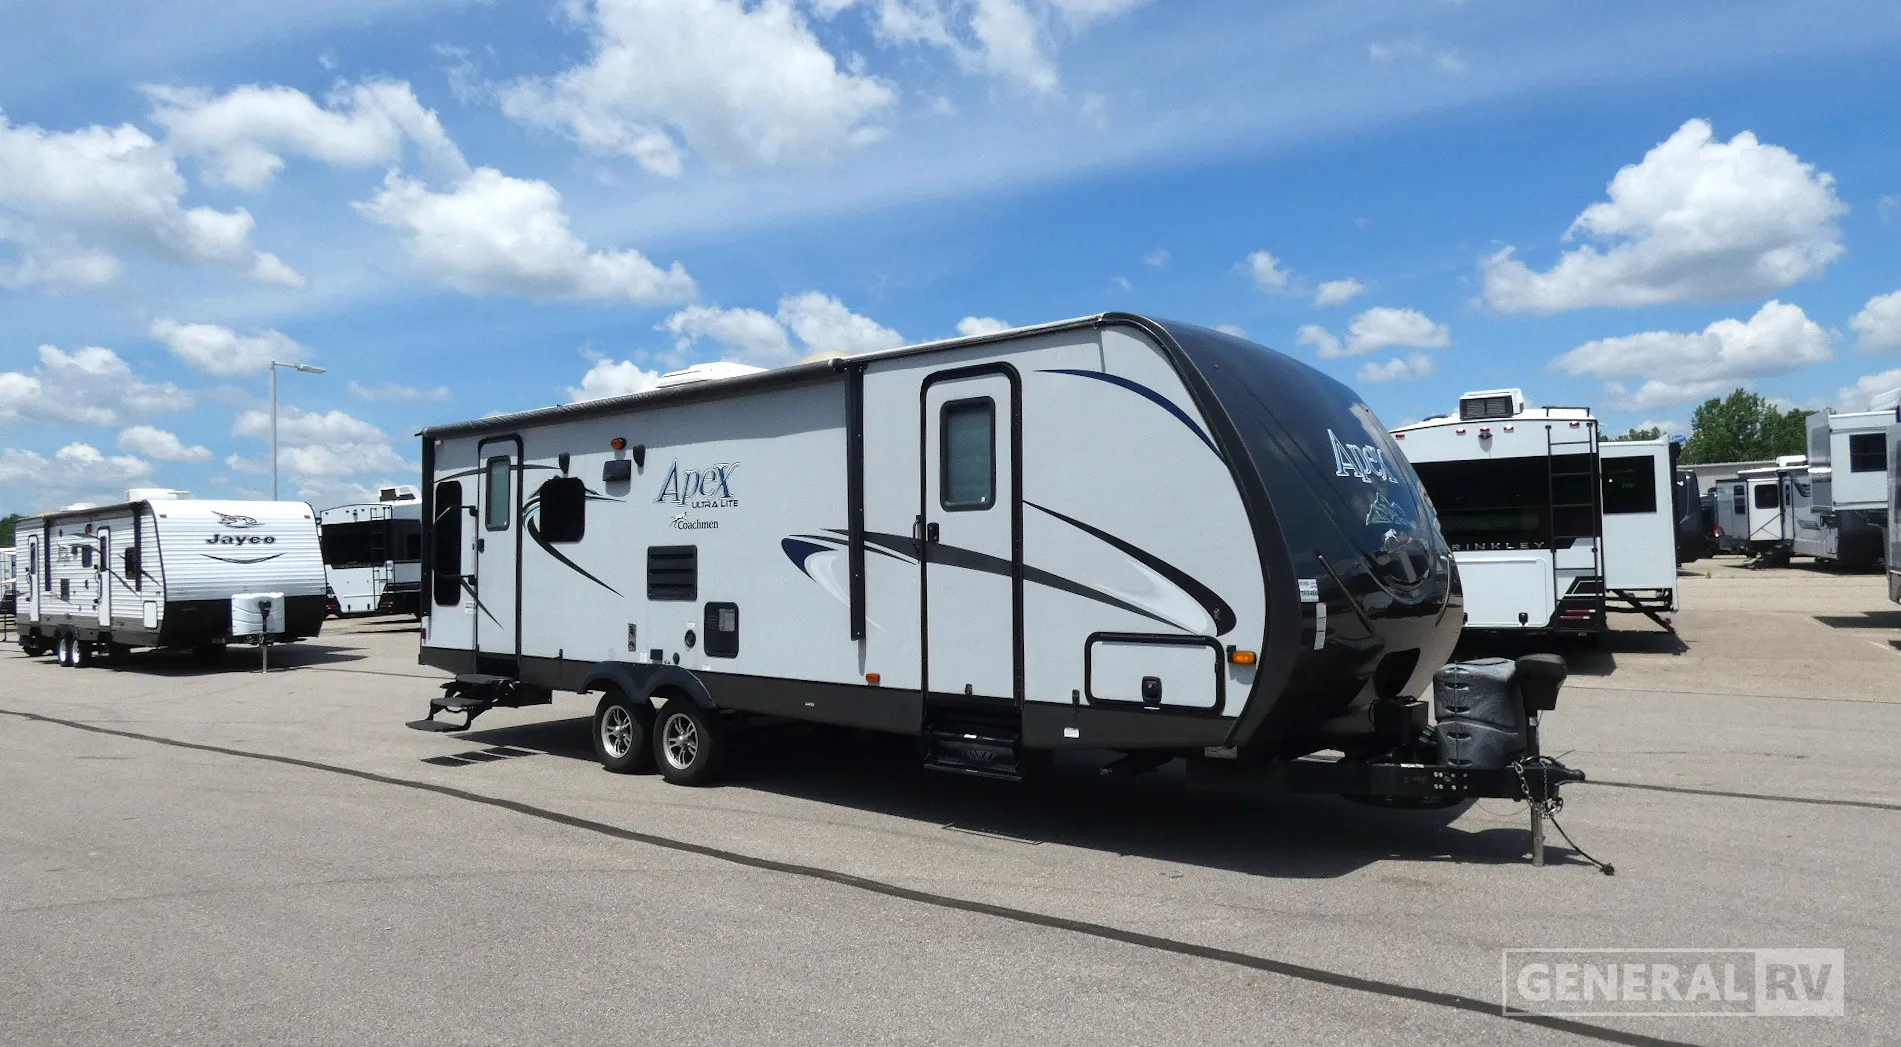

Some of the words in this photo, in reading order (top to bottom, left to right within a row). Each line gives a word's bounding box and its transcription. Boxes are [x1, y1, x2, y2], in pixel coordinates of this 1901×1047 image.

[691, 500, 719, 509] ULTRA
[720, 499, 739, 508] LITE
[677, 519, 719, 530] Coachmen
[205, 533, 276, 546] Jayco
[1451, 541, 1545, 551] RINKLEY
